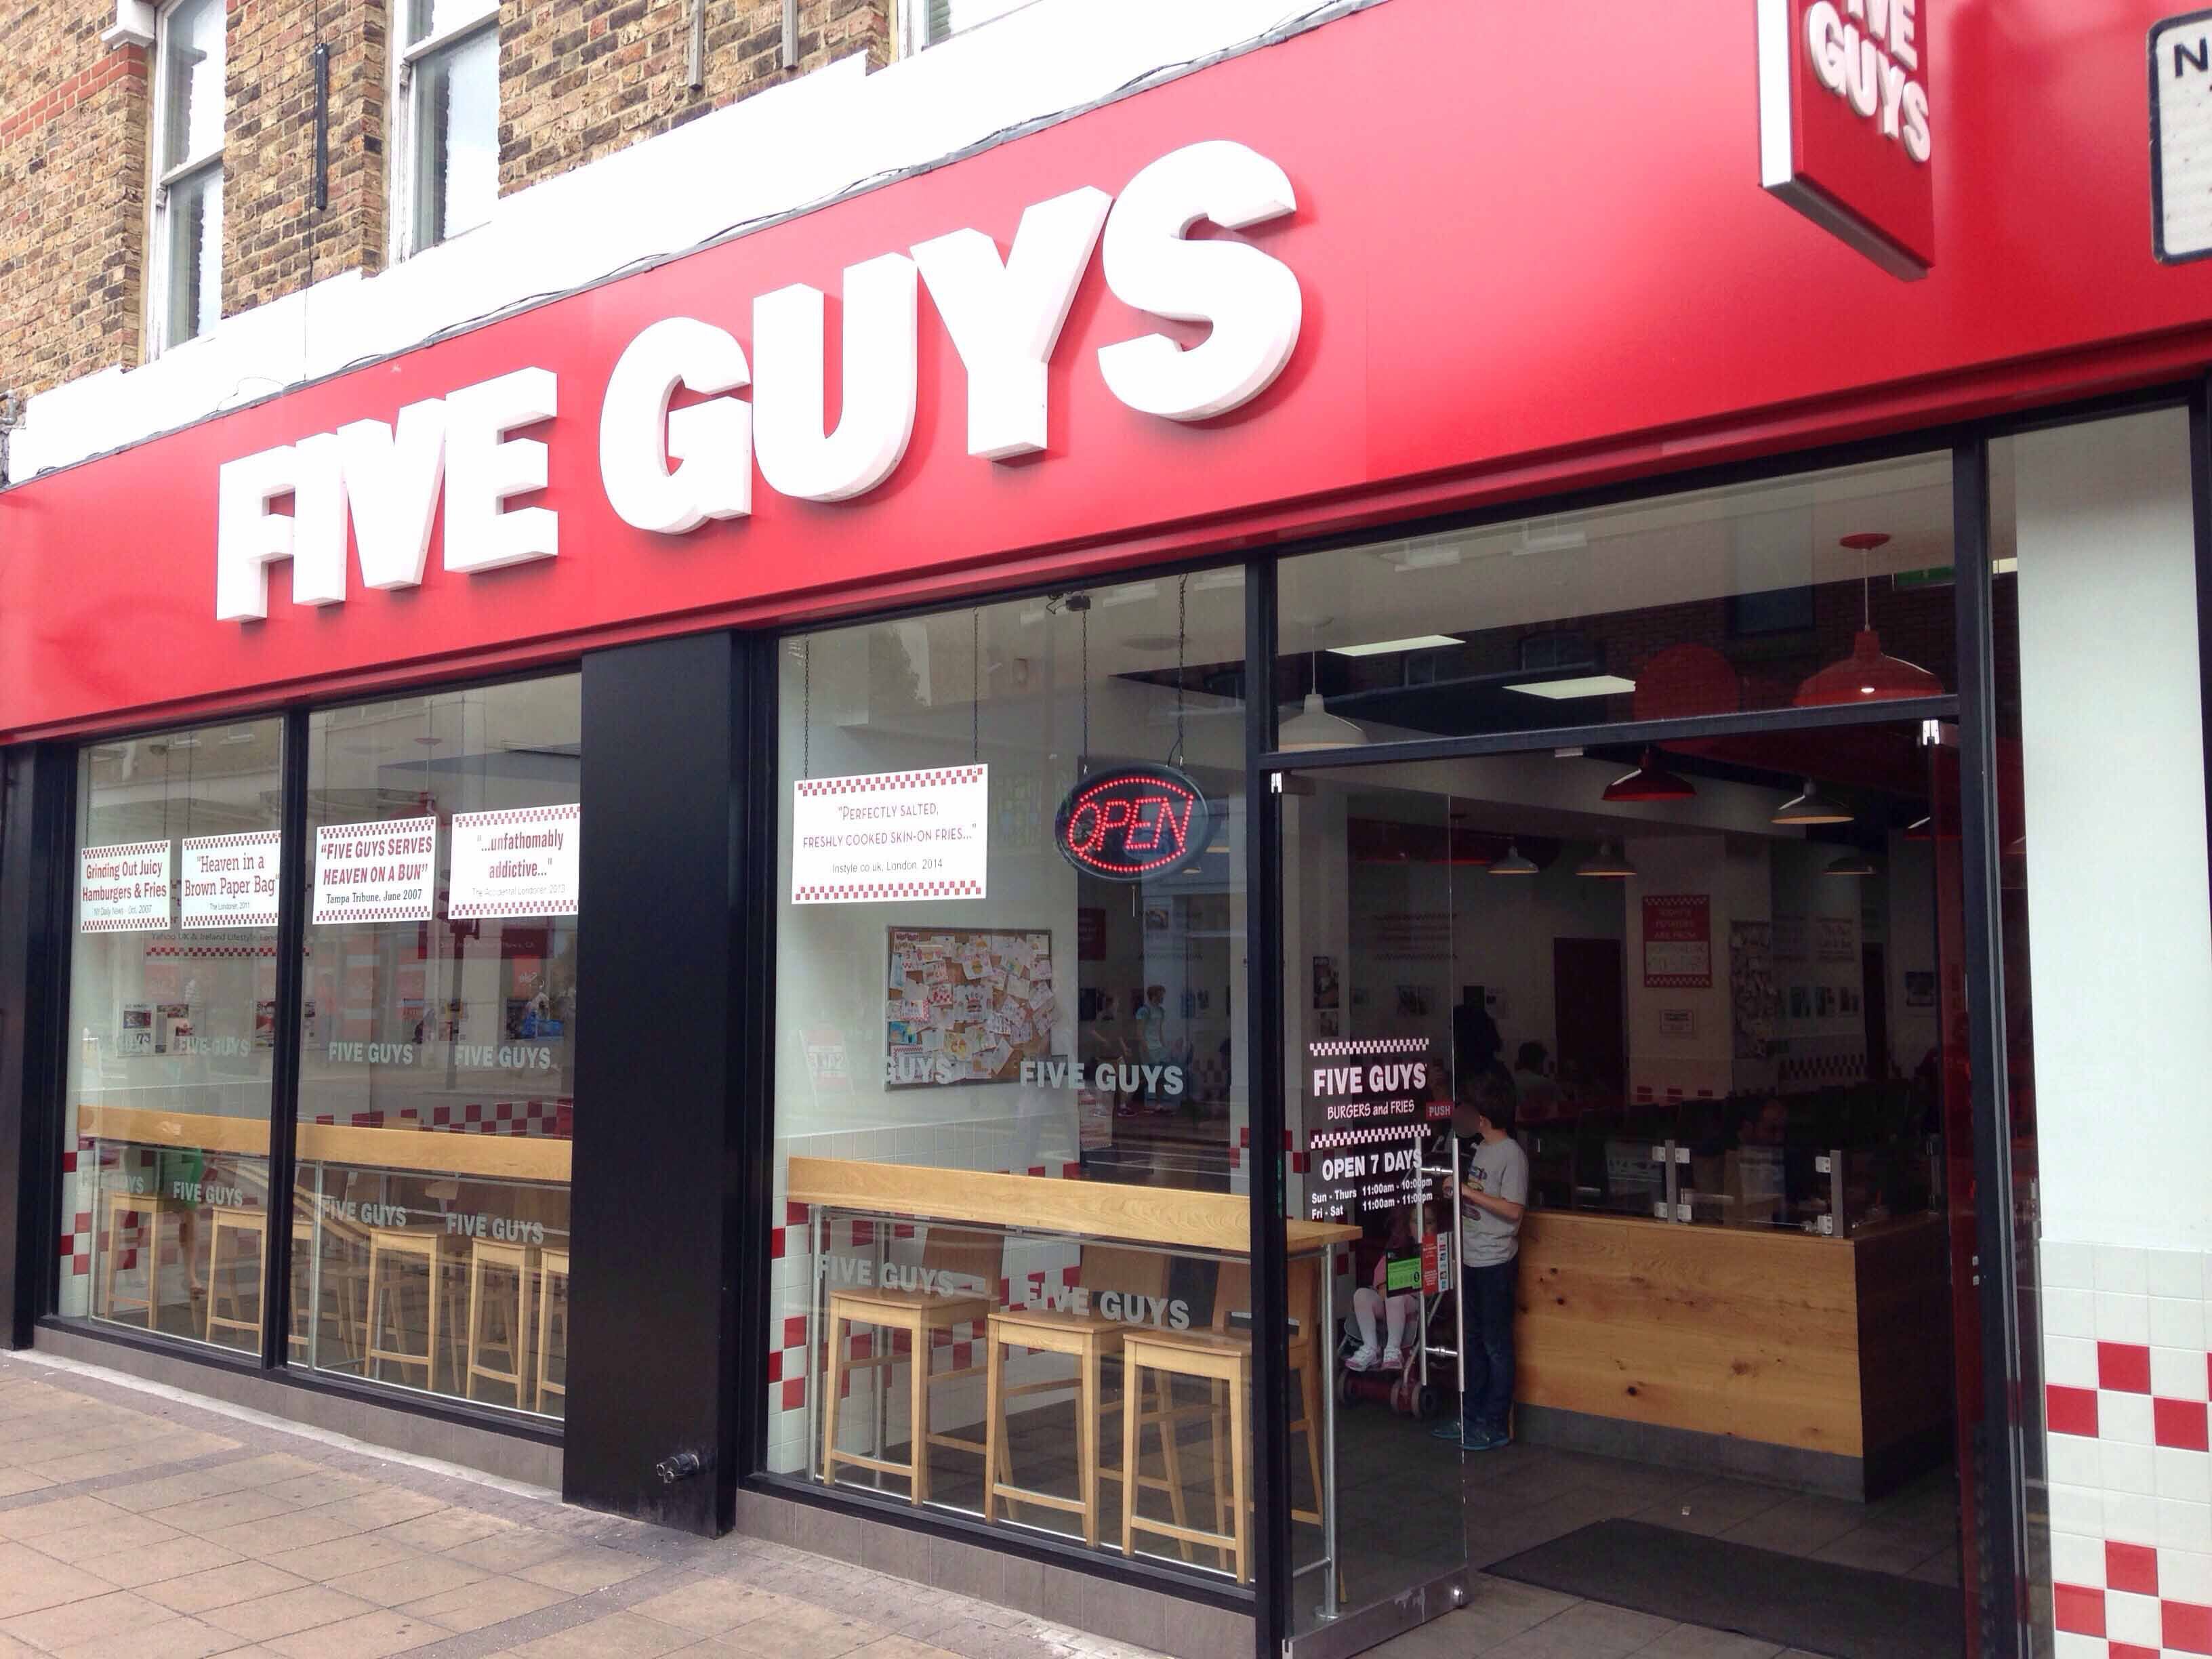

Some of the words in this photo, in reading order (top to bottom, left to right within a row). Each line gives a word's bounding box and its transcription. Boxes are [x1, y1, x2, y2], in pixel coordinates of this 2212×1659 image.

[1808, 1, 1931, 162] GUYS
[216, 365, 560, 622] FIVE
[599, 140, 1303, 534] GUYS
[1068, 796, 1193, 855] OPEN
[355, 840, 385, 858] GUYS
[388, 836, 432, 855] SERVES
[803, 835, 843, 848] FRESHLY
[846, 832, 888, 846] COOKED
[890, 830, 932, 844] SKIN-ON
[86, 862, 120, 880] Grinding
[122, 861, 138, 876] Out
[139, 859, 163, 878] Juicy
[243, 852, 254, 869] in
[258, 856, 264, 869] a
[922, 858, 943, 869] 2014
[323, 867, 368, 885] HEAVEN
[370, 866, 386, 882] ON
[388, 865, 394, 881] A
[82, 885, 131, 903] Hamburgers
[134, 882, 142, 898] &
[144, 882, 167, 897] Fries
[184, 880, 216, 897] Brown
[220, 877, 250, 899] Paper
[326, 893, 350, 905] Tampa
[352, 891, 382, 903] Tribune,
[383, 890, 401, 901] June
[403, 888, 422, 900] 2007
[328, 1042, 363, 1063] FIVE
[368, 1042, 413, 1065] GUYS
[455, 1044, 494, 1067] FIVE
[499, 1046, 552, 1069] GUYS
[1020, 1061, 1085, 1089] FIVE
[1094, 1063, 1184, 1095] GUYS
[1313, 1067, 1363, 1097] FIVE
[1369, 1063, 1427, 1092] GUYS
[1327, 1104, 1371, 1120] BURGERS
[1372, 1105, 1389, 1115] and
[1391, 1099, 1415, 1113] FRIES
[1429, 1105, 1451, 1116] PUSH
[1322, 1155, 1366, 1181] OPEN
[1370, 1154, 1379, 1174] 7
[1384, 1149, 1422, 1172] DAYS
[173, 1180, 201, 1202] FIVE
[205, 1185, 243, 1206] GUYS
[1311, 1193, 1327, 1204] Sun
[1334, 1189, 1357, 1200] Thurs
[1362, 1183, 1395, 1196] 11:00am
[1401, 1178, 1433, 1191] 10:00pm
[321, 1196, 357, 1222] FIVE
[361, 1202, 407, 1227] GUYS
[1311, 1208, 1323, 1220] Fri
[1330, 1205, 1344, 1217] Sat
[1362, 1198, 1395, 1212] 11:00am
[1402, 1192, 1433, 1205] 11:00pm
[445, 1212, 487, 1237] FIVE
[491, 1217, 544, 1245] GUYS
[817, 1254, 873, 1286] FIVE
[879, 1261, 955, 1298] GUYS
[1025, 1279, 1090, 1316] FIVE
[1100, 1290, 1190, 1330] GUYS
